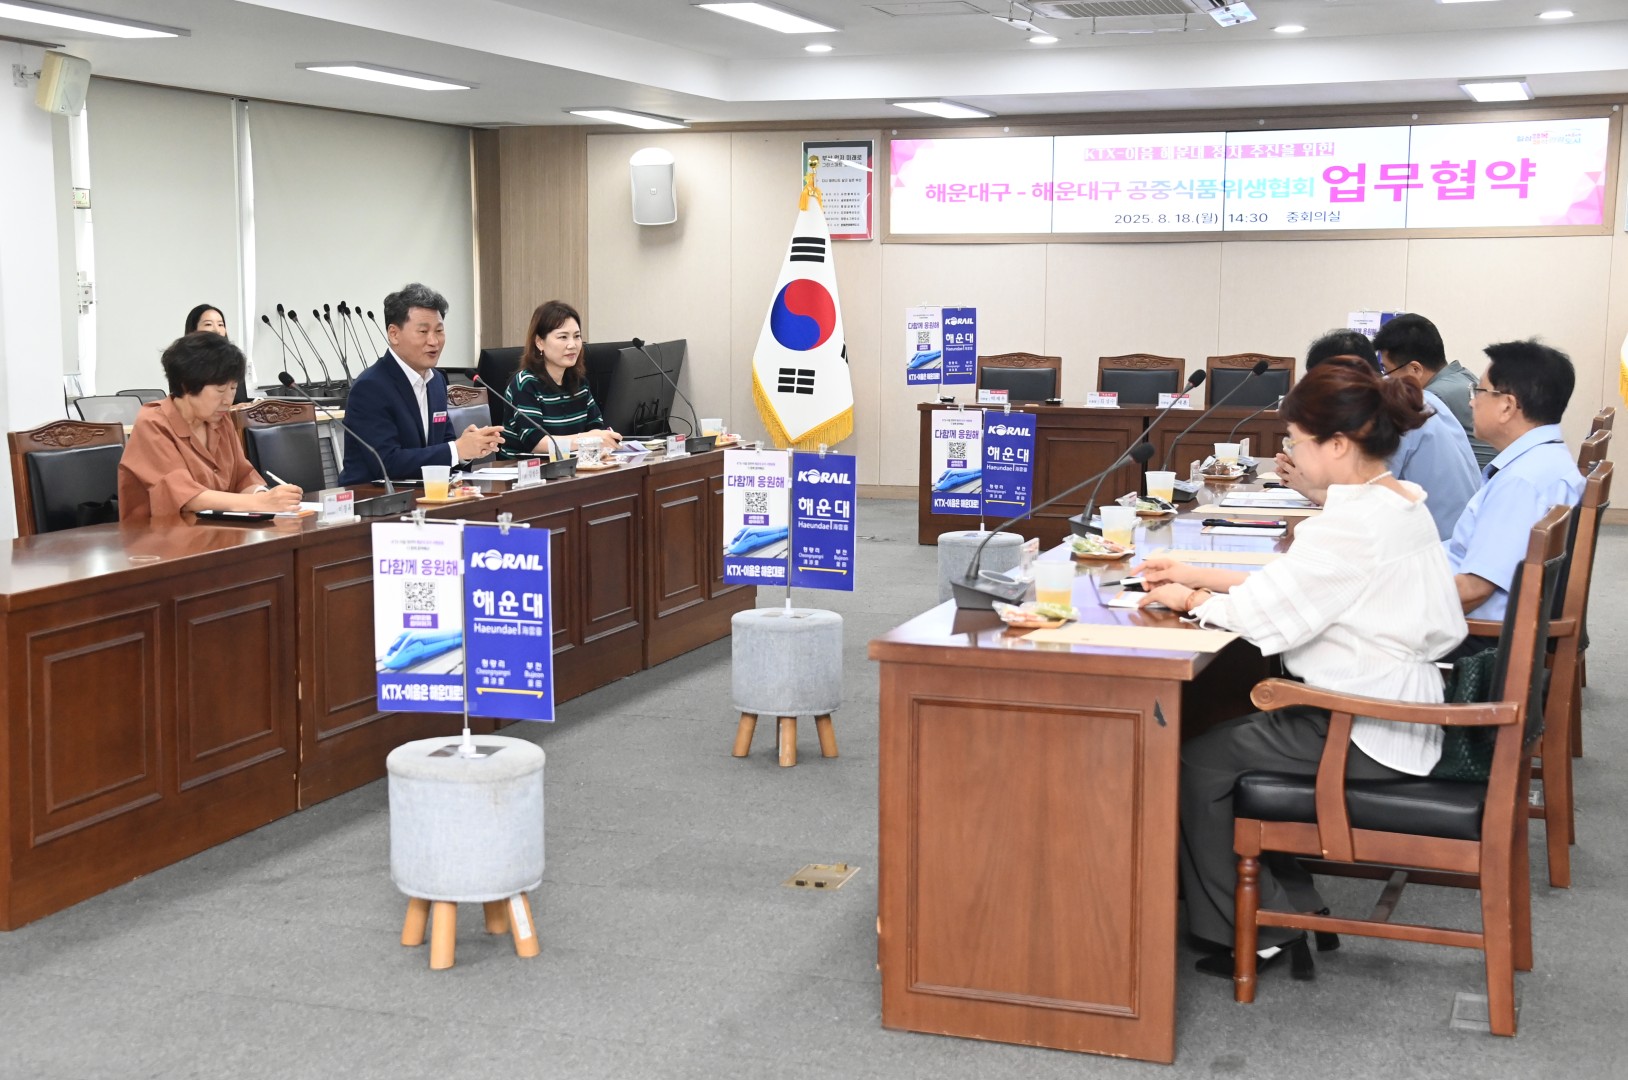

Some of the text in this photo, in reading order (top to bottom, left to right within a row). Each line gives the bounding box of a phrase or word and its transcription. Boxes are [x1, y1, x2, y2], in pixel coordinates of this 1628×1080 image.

[1085, 142, 1335, 161] KTX-이음 해운대 정차 추진을 위한
[925, 183, 1011, 203] 해운대구
[1032, 181, 1121, 202] 해운대구
[1126, 177, 1315, 201] 공중식품위생협회
[1322, 158, 1537, 203] 업무협약
[1114, 210, 1341, 225] 2025. 8. 18.(월) 14:30 중회의실
[945, 317, 974, 325] KORAIL
[946, 333, 973, 343] 해운대
[935, 429, 979, 439] 다함께 응원해
[988, 424, 1031, 436] KORAIL
[987, 446, 1029, 463] 해운대
[727, 475, 784, 488] 다함께 응원해
[798, 469, 851, 484] KORAIL
[798, 497, 850, 518] 해운대
[798, 521, 829, 530] Haeundae
[379, 559, 458, 576] 다함께 응원해
[471, 549, 543, 571] KORAIL
[727, 565, 760, 577] KTX-이음은
[473, 589, 543, 619] 해운대
[474, 622, 518, 635] Haeundae
[382, 684, 429, 701] KTX-이음은
